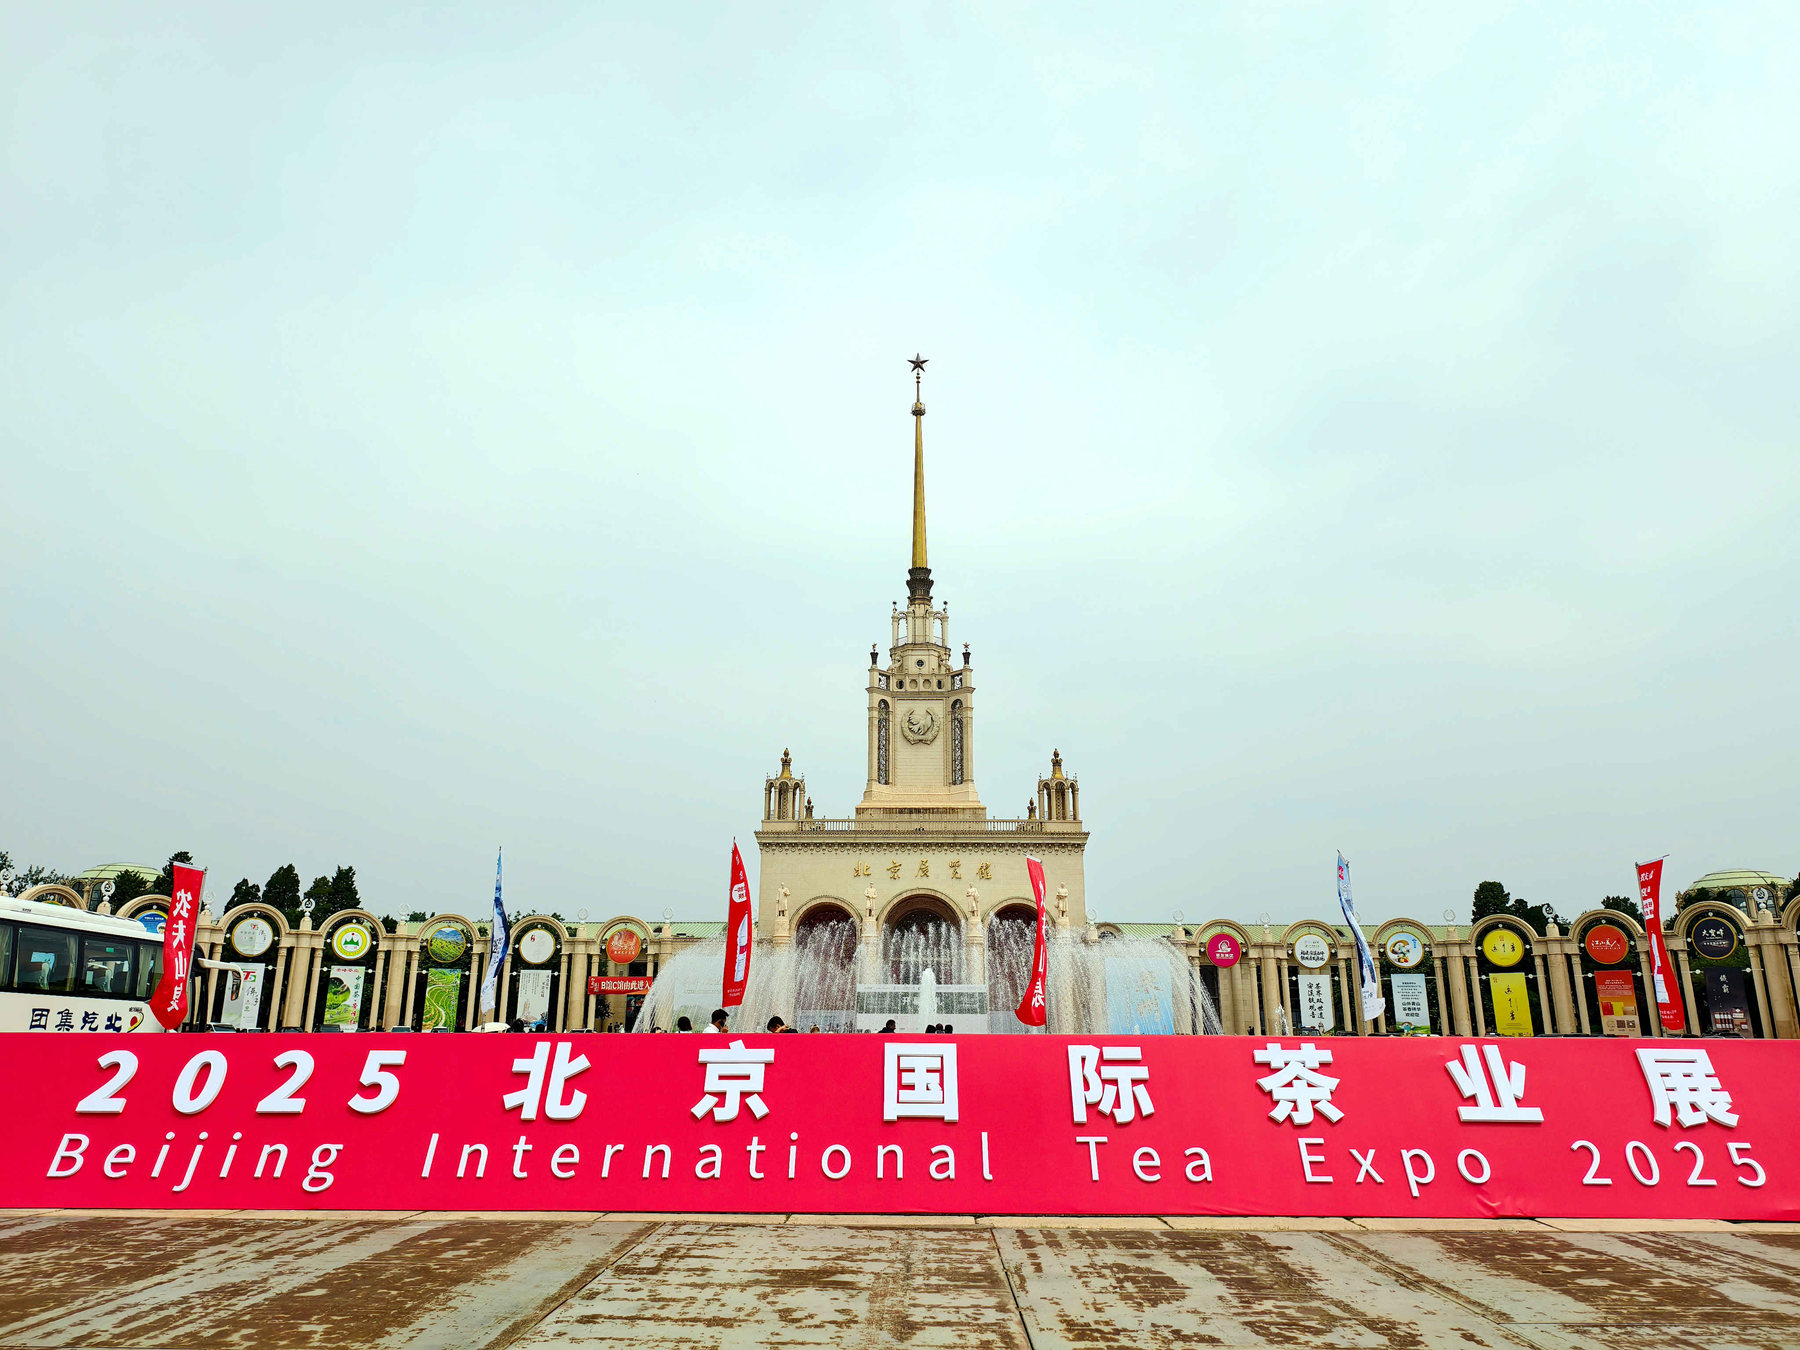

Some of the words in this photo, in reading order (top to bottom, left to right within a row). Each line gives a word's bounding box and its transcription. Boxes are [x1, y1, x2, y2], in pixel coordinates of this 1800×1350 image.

[76, 1050, 407, 1114] 2025
[503, 1040, 1740, 1128] 北京国际茶业展
[47, 1132, 343, 1192] Beijing
[422, 1132, 992, 1180] International
[1076, 1136, 1212, 1182] Tea
[1298, 1138, 1491, 1197] Expo
[1571, 1140, 1767, 1187] 2025
